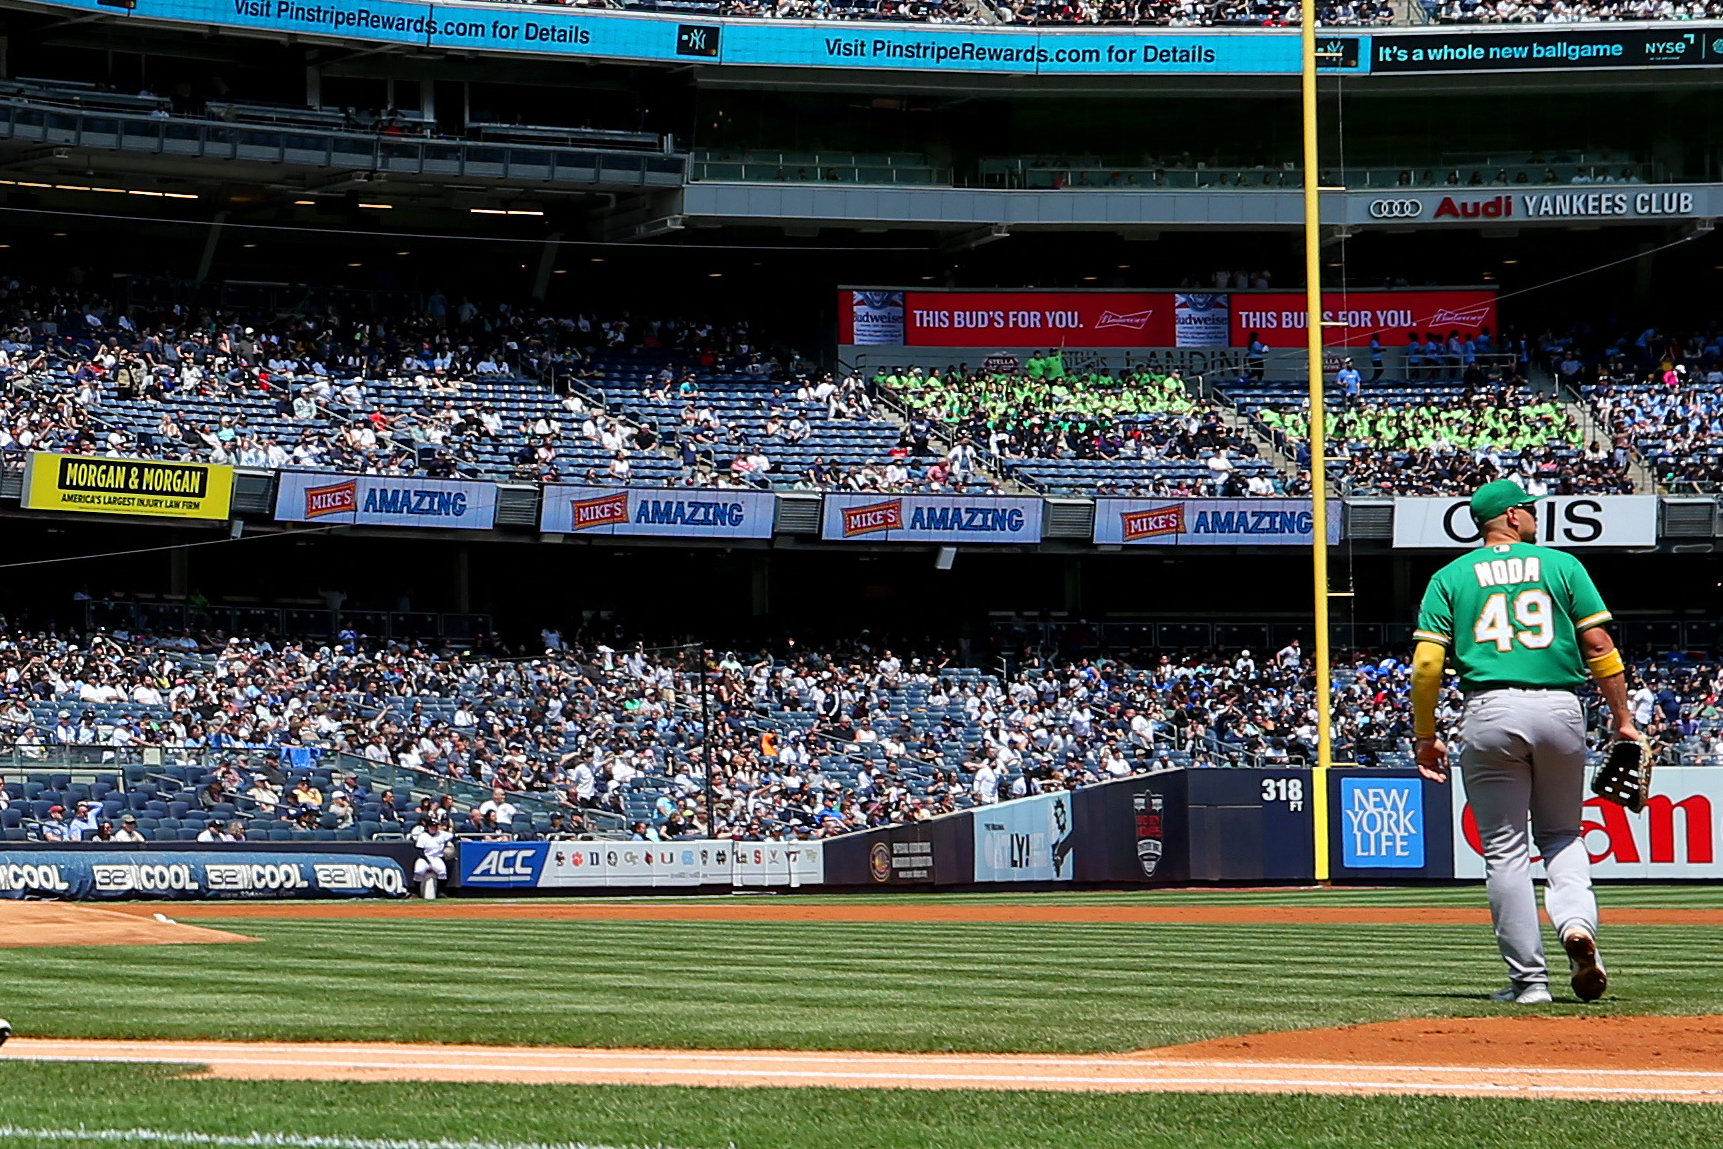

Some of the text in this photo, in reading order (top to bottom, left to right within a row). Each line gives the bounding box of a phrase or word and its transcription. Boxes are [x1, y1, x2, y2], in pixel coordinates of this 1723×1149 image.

[277, 0, 486, 40] PinstripeRewards.com
[490, 20, 520, 40] for
[524, 22, 590, 45] Details
[825, 38, 1215, 64] Visit PinstripeRewards.com for Details
[1379, 40, 1623, 62] It's a whole new ballgame
[1434, 192, 1694, 219] Audi YANKEES CLUB
[913, 310, 1084, 329] THIS BUD'S FOR YOU.
[1239, 311, 1277, 329] THIS
[1338, 310, 1372, 328] FOR
[1376, 309, 1417, 328] YOU.
[66, 463, 201, 493] MORGAN & MORGAN
[61, 493, 200, 510] AMERICA'S LARGEST INJURY LAW FIRM
[312, 487, 467, 516] MIKE'S AMAZING
[579, 500, 745, 526] MIKE'S AMAZING
[850, 507, 1025, 532] MIKE'S AMAZING
[1130, 510, 1314, 534] MIKE'S AMAZING
[1443, 500, 1603, 543] OIS
[1473, 556, 1540, 588] NODA
[1474, 589, 1556, 653] 49
[1261, 778, 1303, 802] 318
[1353, 788, 1410, 811] NEW
[1288, 801, 1303, 812] FT
[1345, 808, 1418, 836] YORK
[1356, 832, 1410, 857] LIFE
[473, 849, 536, 875] ACC
[9, 864, 69, 891] COOL
[140, 864, 199, 890] COOL
[252, 864, 309, 889] COOL
[359, 865, 408, 895] COOL
